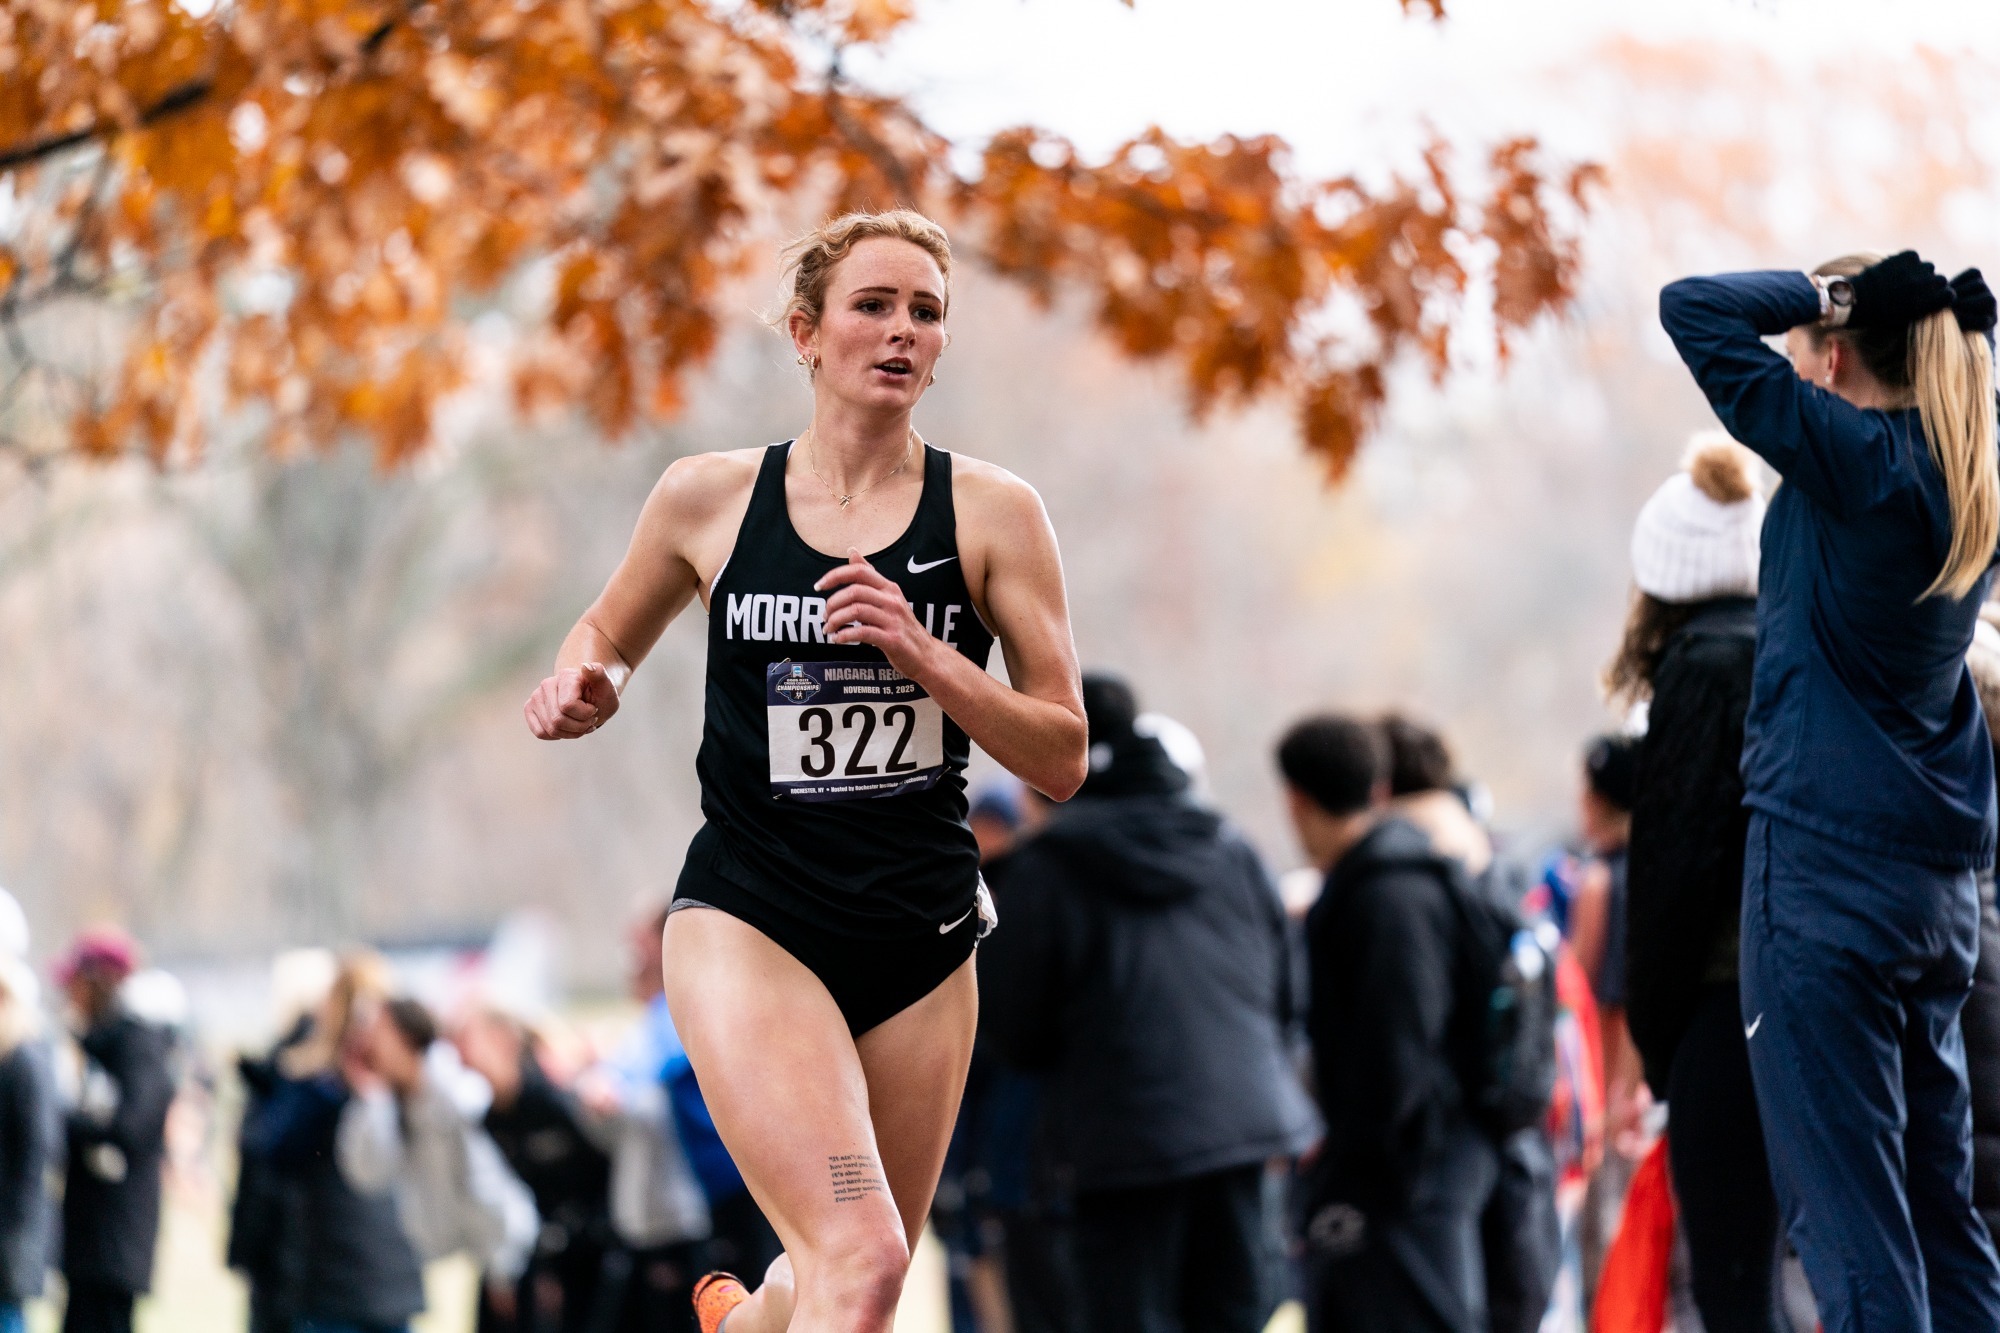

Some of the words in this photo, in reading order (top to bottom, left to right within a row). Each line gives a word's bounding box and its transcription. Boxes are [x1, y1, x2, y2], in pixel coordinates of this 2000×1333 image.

[726, 593, 962, 650] MORRLE
[824, 668, 875, 681] NIAGARA
[843, 685, 880, 694] NOVEMBER
[882, 686, 894, 695] 15,
[896, 684, 915, 694] 2025
[798, 704, 917, 778] 322
[831, 785, 848, 793] Hosted
[855, 783, 879, 791] Rochester
